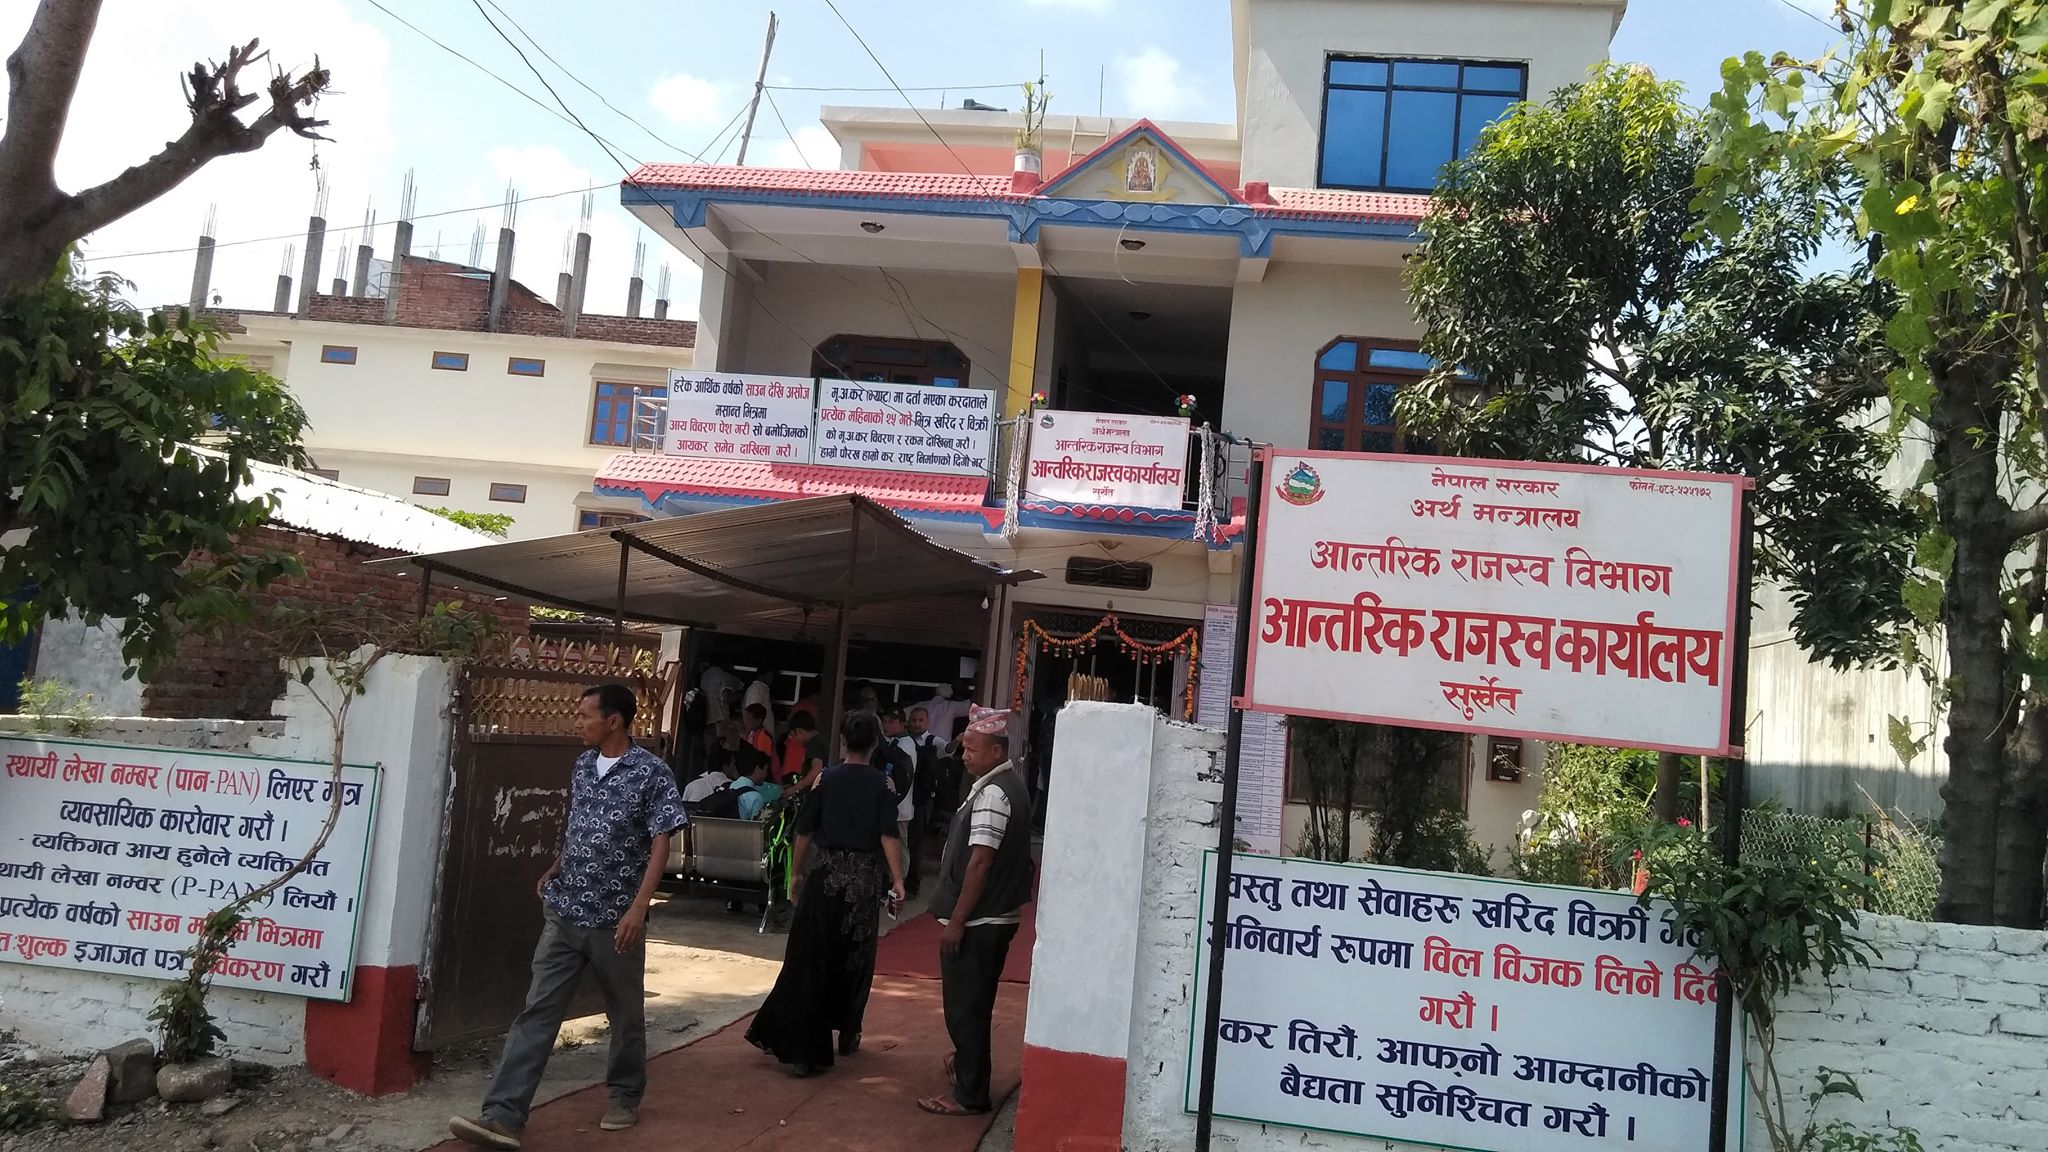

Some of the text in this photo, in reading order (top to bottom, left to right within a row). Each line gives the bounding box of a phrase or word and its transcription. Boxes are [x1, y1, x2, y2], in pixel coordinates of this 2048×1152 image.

[673, 376, 692, 393] हरेक
[722, 379, 744, 395] वर्षको
[745, 383, 766, 398] साउन
[769, 382, 784, 398] देखि
[786, 384, 810, 399] असोज
[893, 391, 904, 404] मा
[906, 390, 921, 405] दर्ता
[923, 393, 946, 406] भएका
[669, 420, 687, 431] आय
[690, 418, 716, 433] विवरण
[719, 420, 732, 435] पेश
[735, 421, 750, 436] गरी
[752, 423, 763, 436] सो
[743, 402, 767, 419] भित्रमा
[821, 405, 846, 421] प्रत्येक
[848, 407, 884, 424] महिनाको
[934, 413, 957, 429] खरिद
[959, 418, 965, 430] र
[677, 439, 709, 451] आयकर
[714, 440, 734, 454] समेत
[740, 441, 770, 456] दाखिला
[826, 427, 837, 440] को
[871, 430, 895, 444] विवरण
[897, 435, 903, 445] र
[1056, 438, 1164, 456] आन्तरिक राजस्व विभाग
[1031, 455, 1181, 486] आन्तरिक राजस्व कार्यालय
[1431, 467, 1560, 499] नेपाल सरकार
[1410, 494, 1581, 532] अर्थ मन्त्रालय
[1310, 536, 1673, 600] आन्तरिक राजस्व विभाग
[1262, 592, 1723, 686] आन्तरिक राजस्व कार्यालय
[1440, 676, 1523, 721] सुर्खेत
[6, 751, 59, 779] स्थायी
[62, 753, 107, 784] लेखा
[266, 768, 318, 803] लिएर
[60, 798, 156, 829] व्यवसायिक
[32, 831, 120, 856] व्यक्तिगत
[126, 842, 172, 861] आय
[176, 845, 233, 867] हुनेले
[0, 862, 46, 881] थायी
[51, 864, 101, 886] लेखा
[0, 894, 61, 919] प्रत्येक
[65, 901, 121, 927] वर्षको
[126, 910, 183, 934] साउन
[256, 917, 324, 949] भित्रमा
[1229, 873, 1282, 912] वस्तु
[1291, 879, 1349, 911] तथा
[1472, 893, 1558, 936] खरिद
[1568, 900, 1650, 944] विक्री
[74, 940, 149, 967] इजाजत
[154, 949, 187, 971] पत्र
[206, 949, 285, 982] विकरण
[1207, 915, 1322, 958] निवार्य
[1494, 944, 1584, 987] विजक
[1595, 955, 1663, 998] लिने
[1220, 1018, 1278, 1049] कर
[1513, 1054, 1710, 1102] आम्दानीको
[1376, 1080, 1532, 1127] सुनिश्चित
